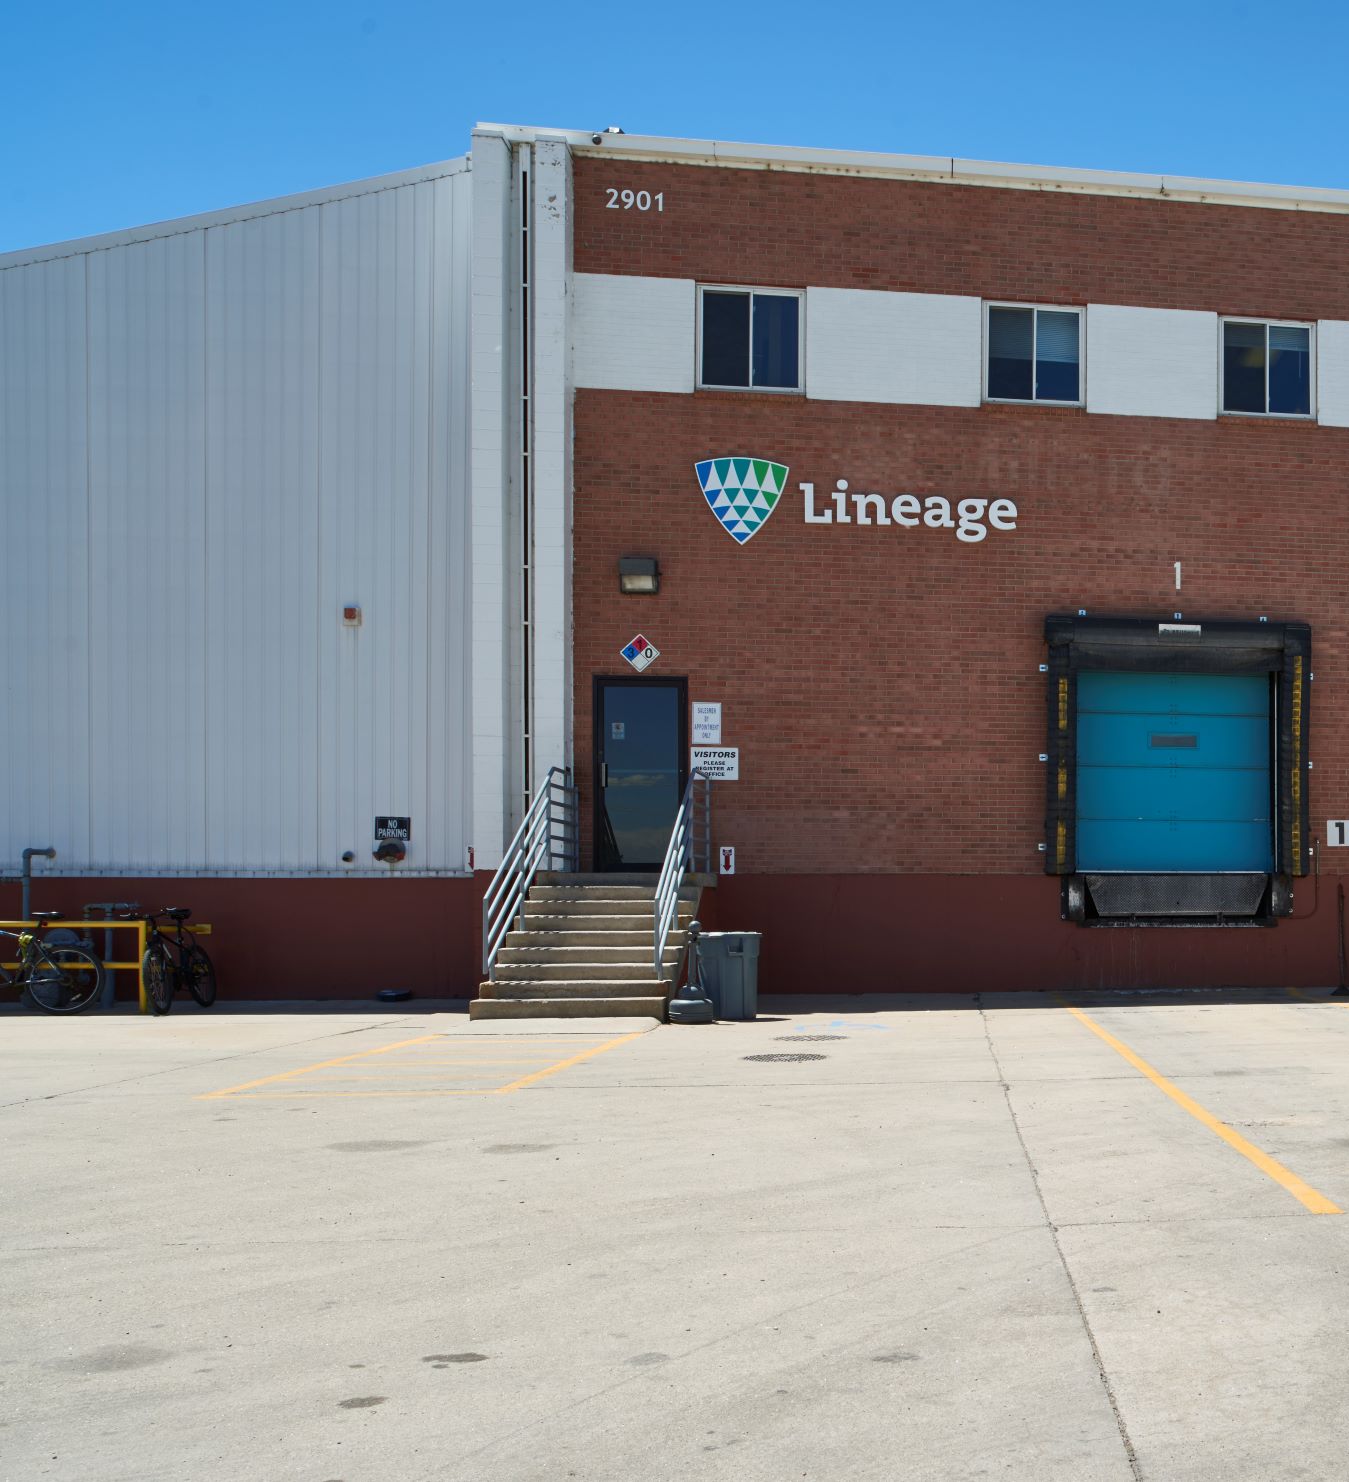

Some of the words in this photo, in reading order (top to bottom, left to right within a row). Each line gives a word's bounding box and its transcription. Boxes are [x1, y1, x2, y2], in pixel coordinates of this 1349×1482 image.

[605, 188, 663, 212] 2901
[799, 479, 1018, 543] Lineage
[1173, 561, 1181, 590] 1
[627, 647, 635, 658] 3
[645, 648, 652, 658] 0
[694, 723, 719, 731] APPOINTMENT
[388, 820, 398, 828] NO
[378, 828, 407, 837] PARKING
[1334, 821, 1345, 845] 1
